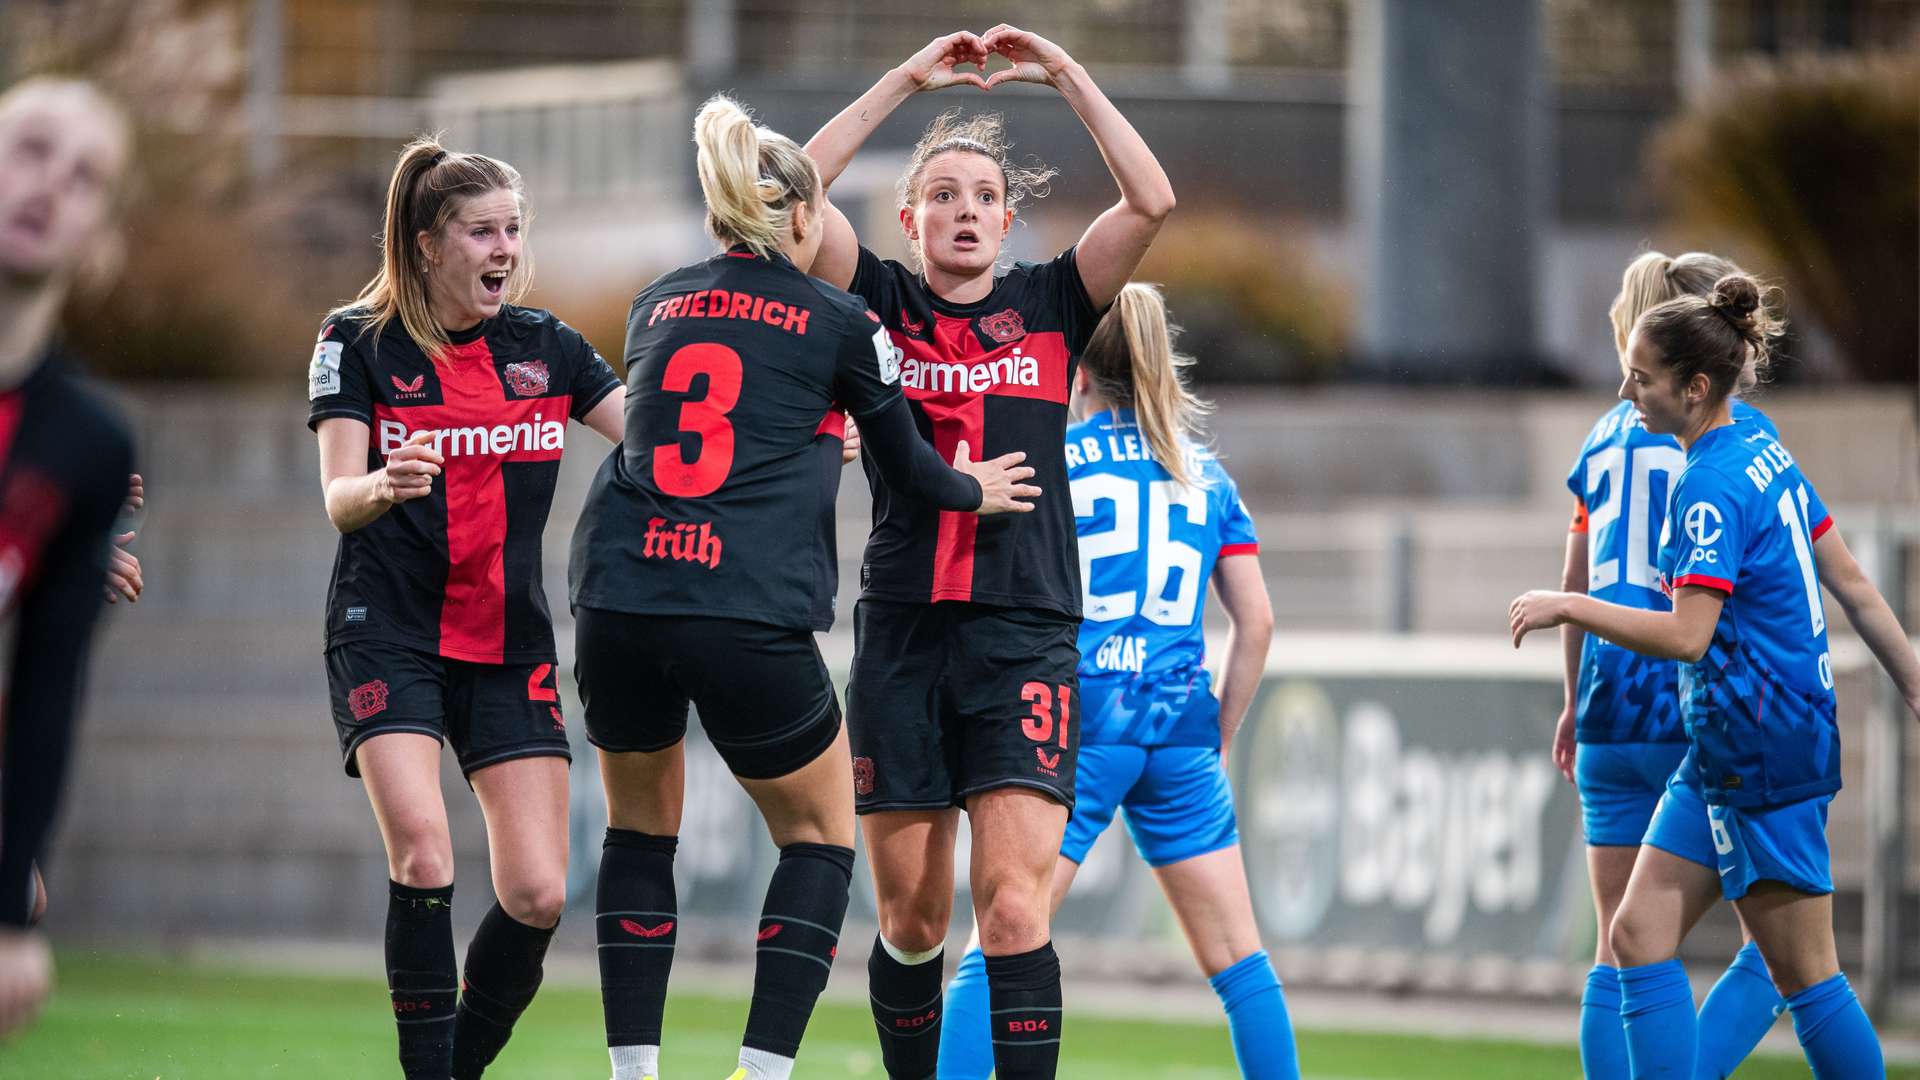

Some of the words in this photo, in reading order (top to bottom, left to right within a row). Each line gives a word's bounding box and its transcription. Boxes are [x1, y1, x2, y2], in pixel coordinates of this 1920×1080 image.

[648, 289, 810, 335] FRIEDRICH
[653, 342, 743, 498] 3
[1065, 437, 1102, 469] RB
[1745, 455, 1773, 493] RB
[1586, 445, 1688, 592] 20
[1070, 472, 1208, 626] 26
[1095, 635, 1147, 672] GRAF
[1021, 681, 1071, 750] 31
